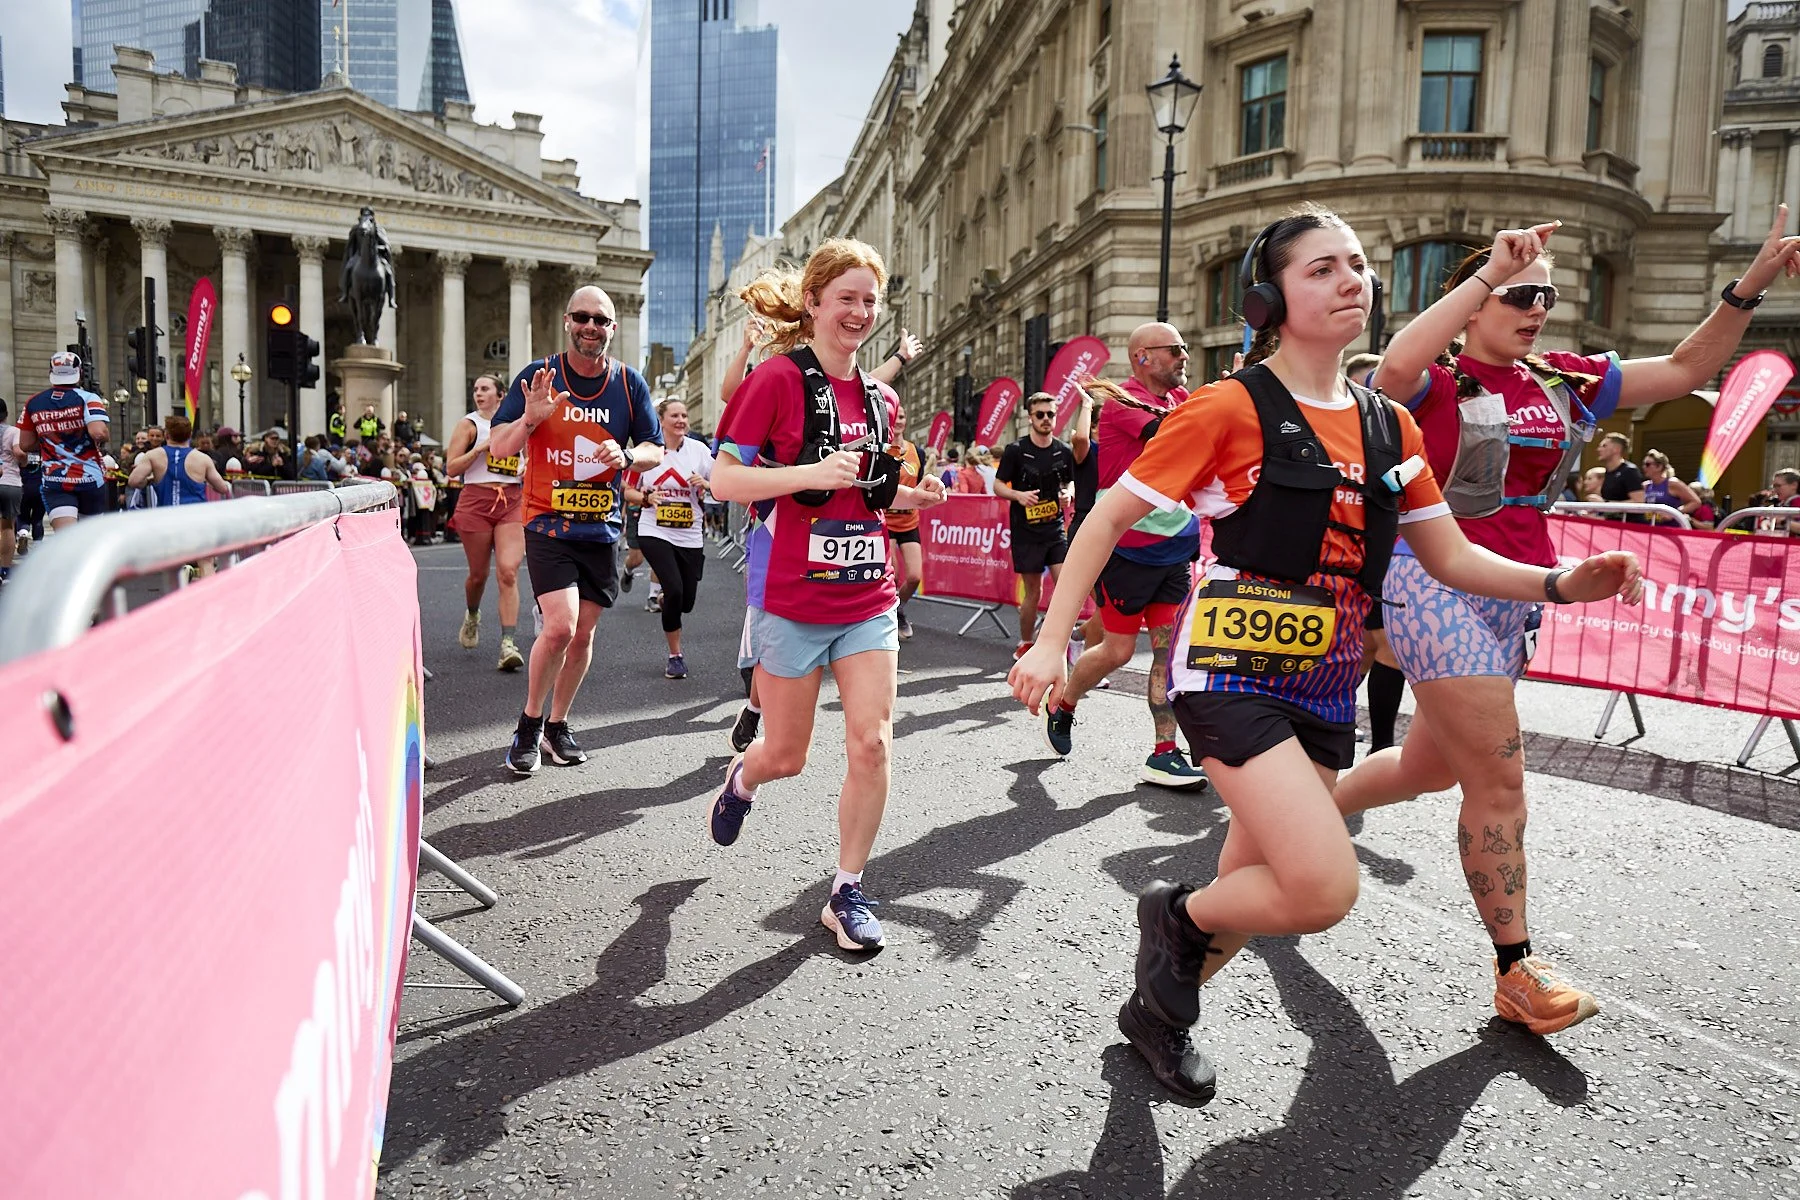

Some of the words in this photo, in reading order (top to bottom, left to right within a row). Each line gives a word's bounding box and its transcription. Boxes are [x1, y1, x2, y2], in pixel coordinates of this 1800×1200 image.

[189, 297, 209, 370] Tommy's
[1055, 351, 1092, 405] ommy's
[1716, 367, 1772, 436] Tommy's
[563, 406, 610, 423] JOHN
[981, 389, 1010, 436] Tommy's
[1537, 426, 1555, 434] baby
[546, 447, 573, 466] MS
[557, 493, 609, 508] 14563
[1029, 503, 1057, 516] 12406
[661, 509, 692, 519] 13548
[930, 519, 1012, 553] Tommy's
[823, 539, 875, 560] 9121
[960, 555, 970, 563] and
[971, 556, 985, 566] baby
[986, 557, 1008, 569] charity
[1236, 584, 1291, 600] BASTONI
[1204, 606, 1324, 647] 13968
[1546, 608, 1572, 624] The
[1576, 615, 1660, 638] pregnancy
[1663, 627, 1690, 641] and
[1692, 632, 1732, 655] baby
[1737, 641, 1800, 665] charity
